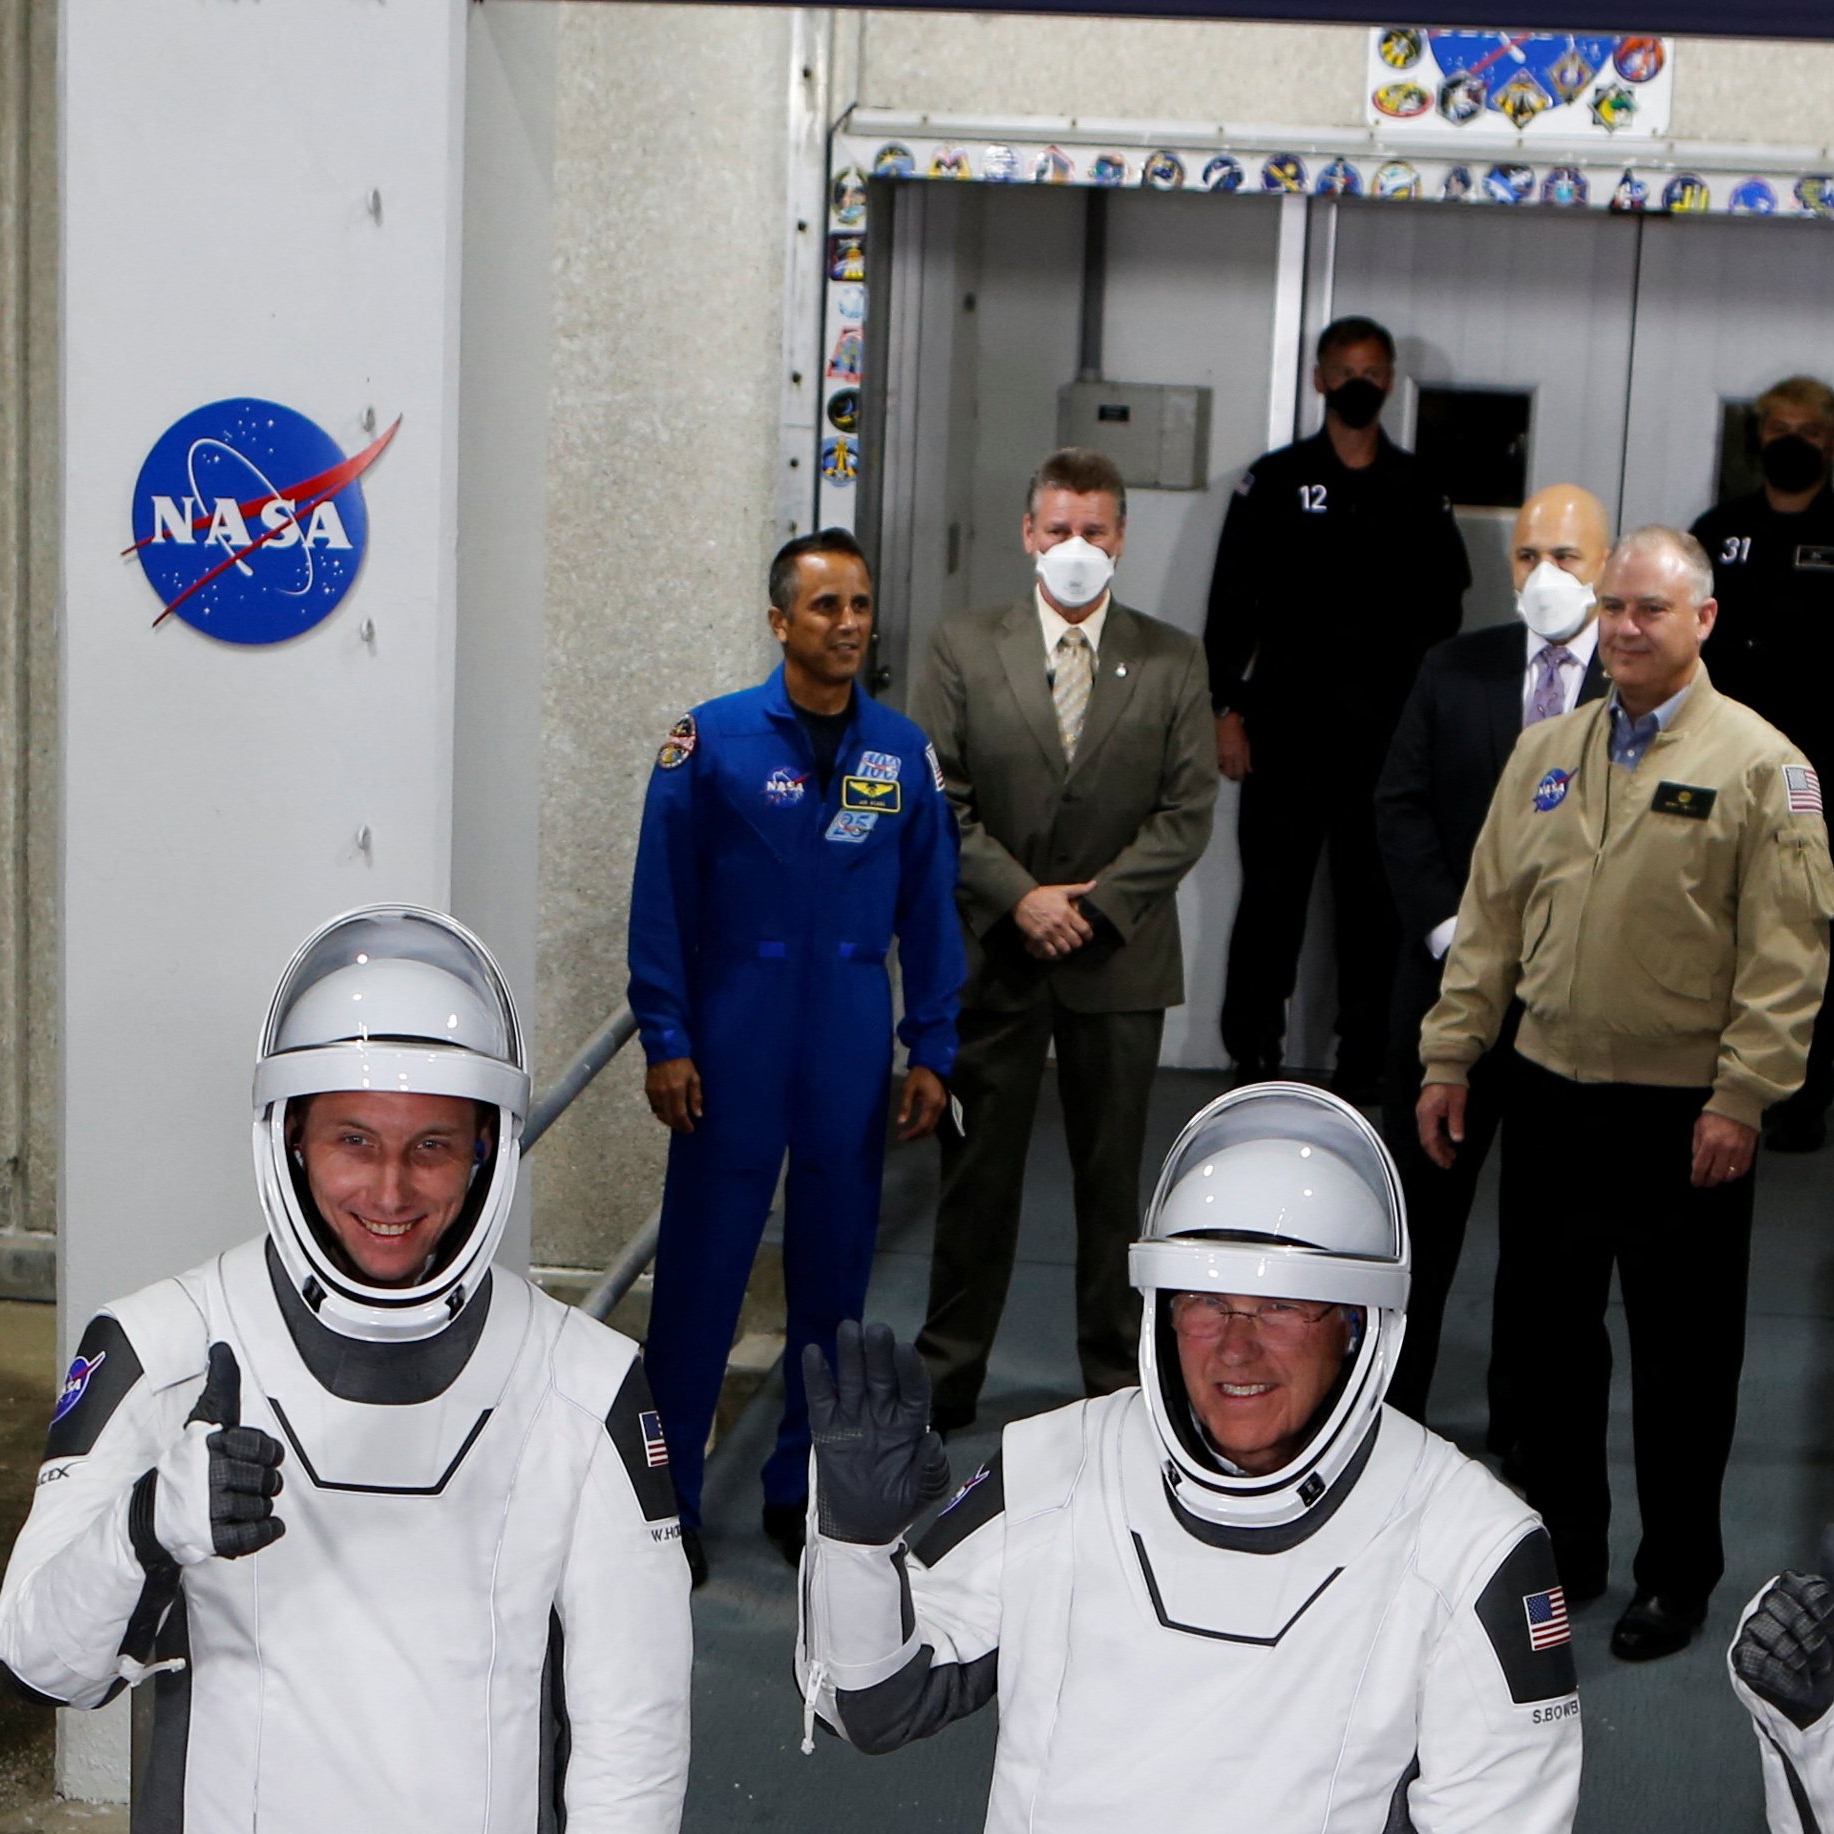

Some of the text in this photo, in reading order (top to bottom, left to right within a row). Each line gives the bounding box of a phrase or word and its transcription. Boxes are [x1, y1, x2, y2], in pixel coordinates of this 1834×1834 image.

[1298, 484, 1328, 511] 12
[151, 495, 354, 550] NASA
[1720, 536, 1752, 564] 31
[766, 780, 805, 792] NASA
[1539, 782, 1565, 795] NASA
